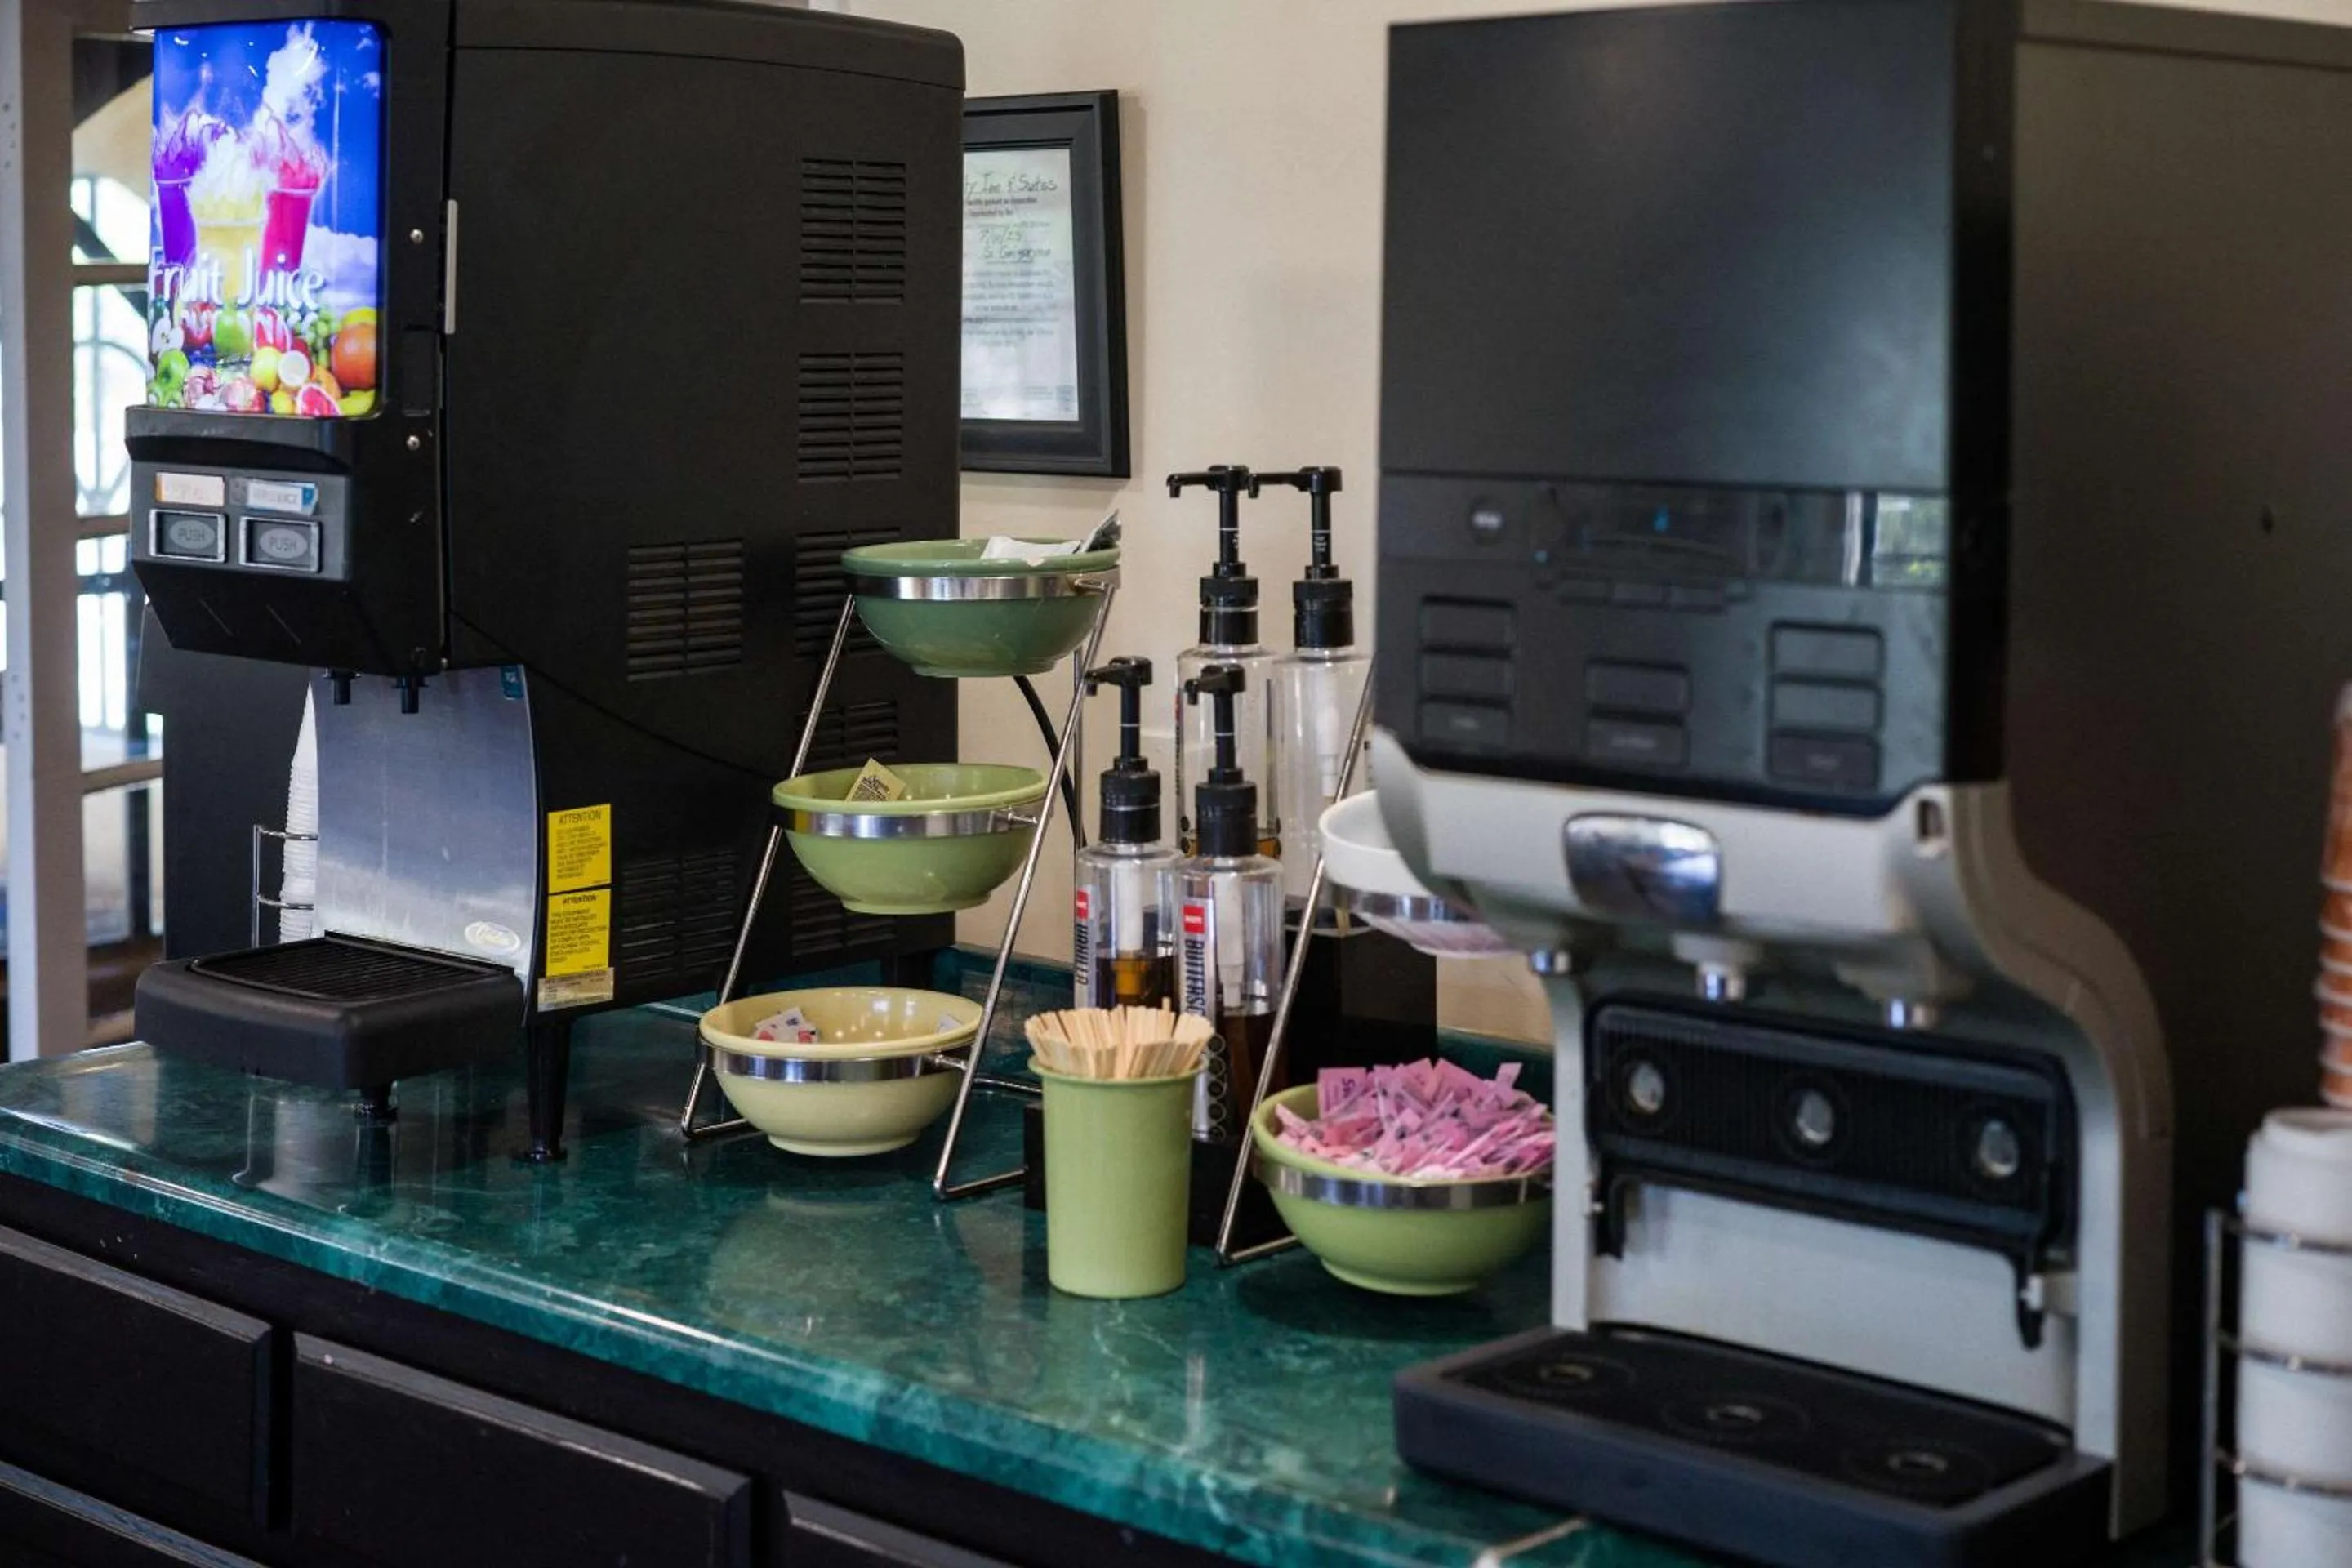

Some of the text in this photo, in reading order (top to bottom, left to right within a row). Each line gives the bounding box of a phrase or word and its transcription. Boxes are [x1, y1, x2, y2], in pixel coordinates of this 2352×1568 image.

[151, 246, 325, 310] Fruit Juice
[178, 528, 205, 542] PUSH
[269, 537, 297, 552] PUSH
[559, 809, 601, 824] ATTENTION
[563, 894, 597, 905] ATTENTION
[1076, 924, 1089, 986] VANILLA
